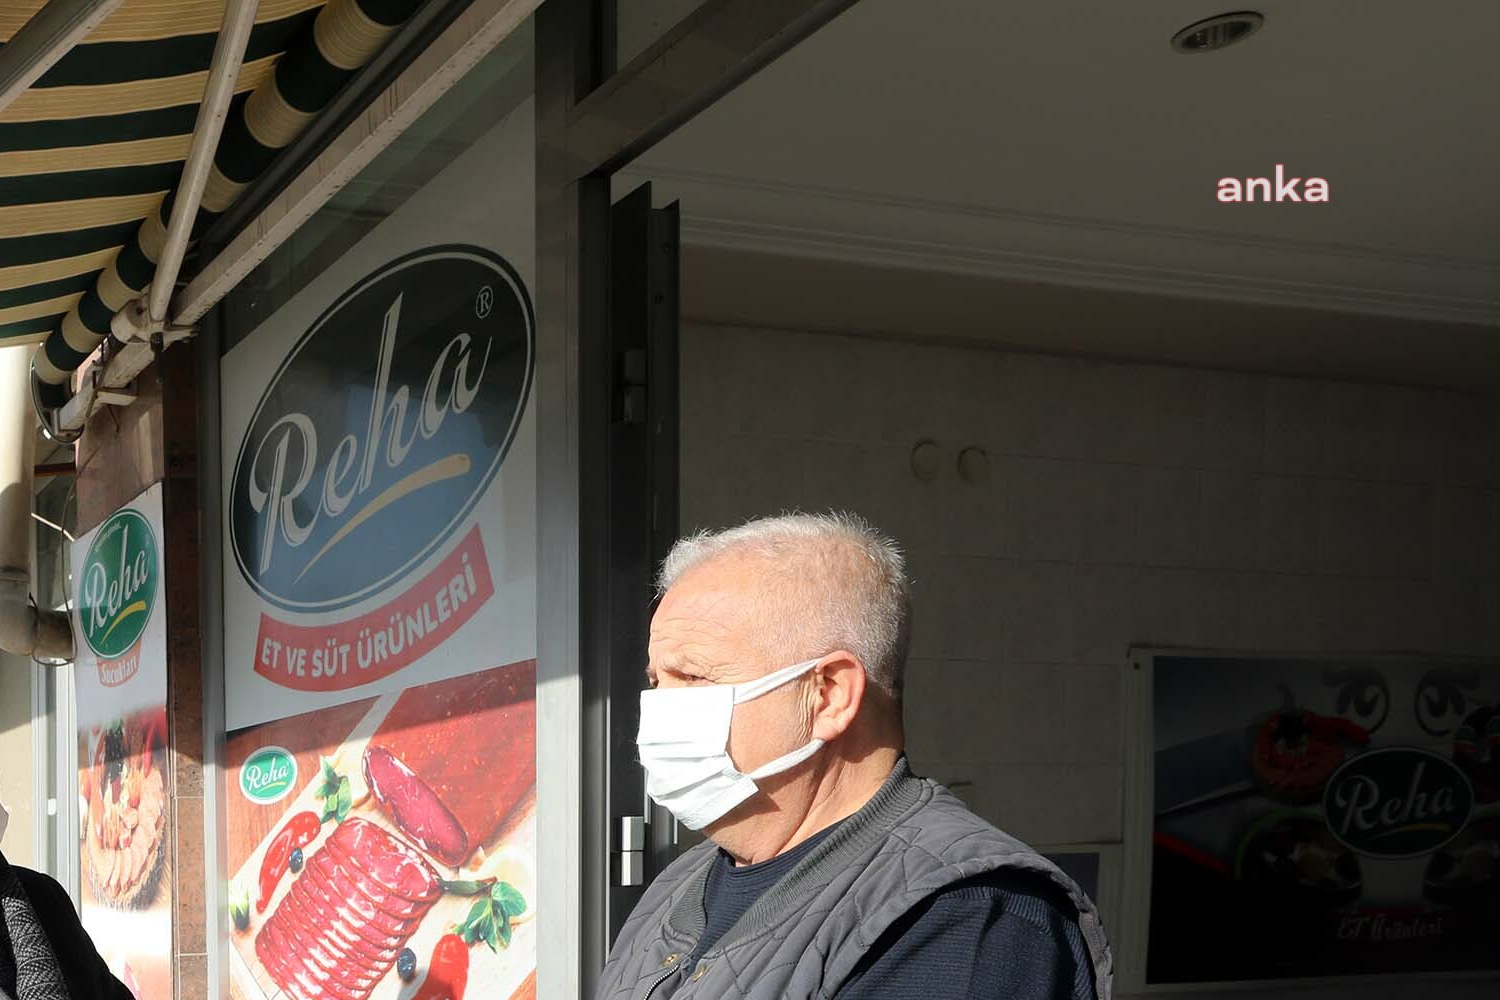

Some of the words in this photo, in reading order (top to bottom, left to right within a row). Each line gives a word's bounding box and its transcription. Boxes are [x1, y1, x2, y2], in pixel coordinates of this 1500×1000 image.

[249, 291, 493, 576] Reha
[85, 523, 149, 638] Reha
[261, 637, 282, 669] ET
[285, 646, 306, 677] VE
[311, 638, 351, 678] SÜT
[357, 551, 477, 669] ÜRÜNLERİ
[246, 757, 288, 791] Reha
[1335, 761, 1456, 835] Reha
